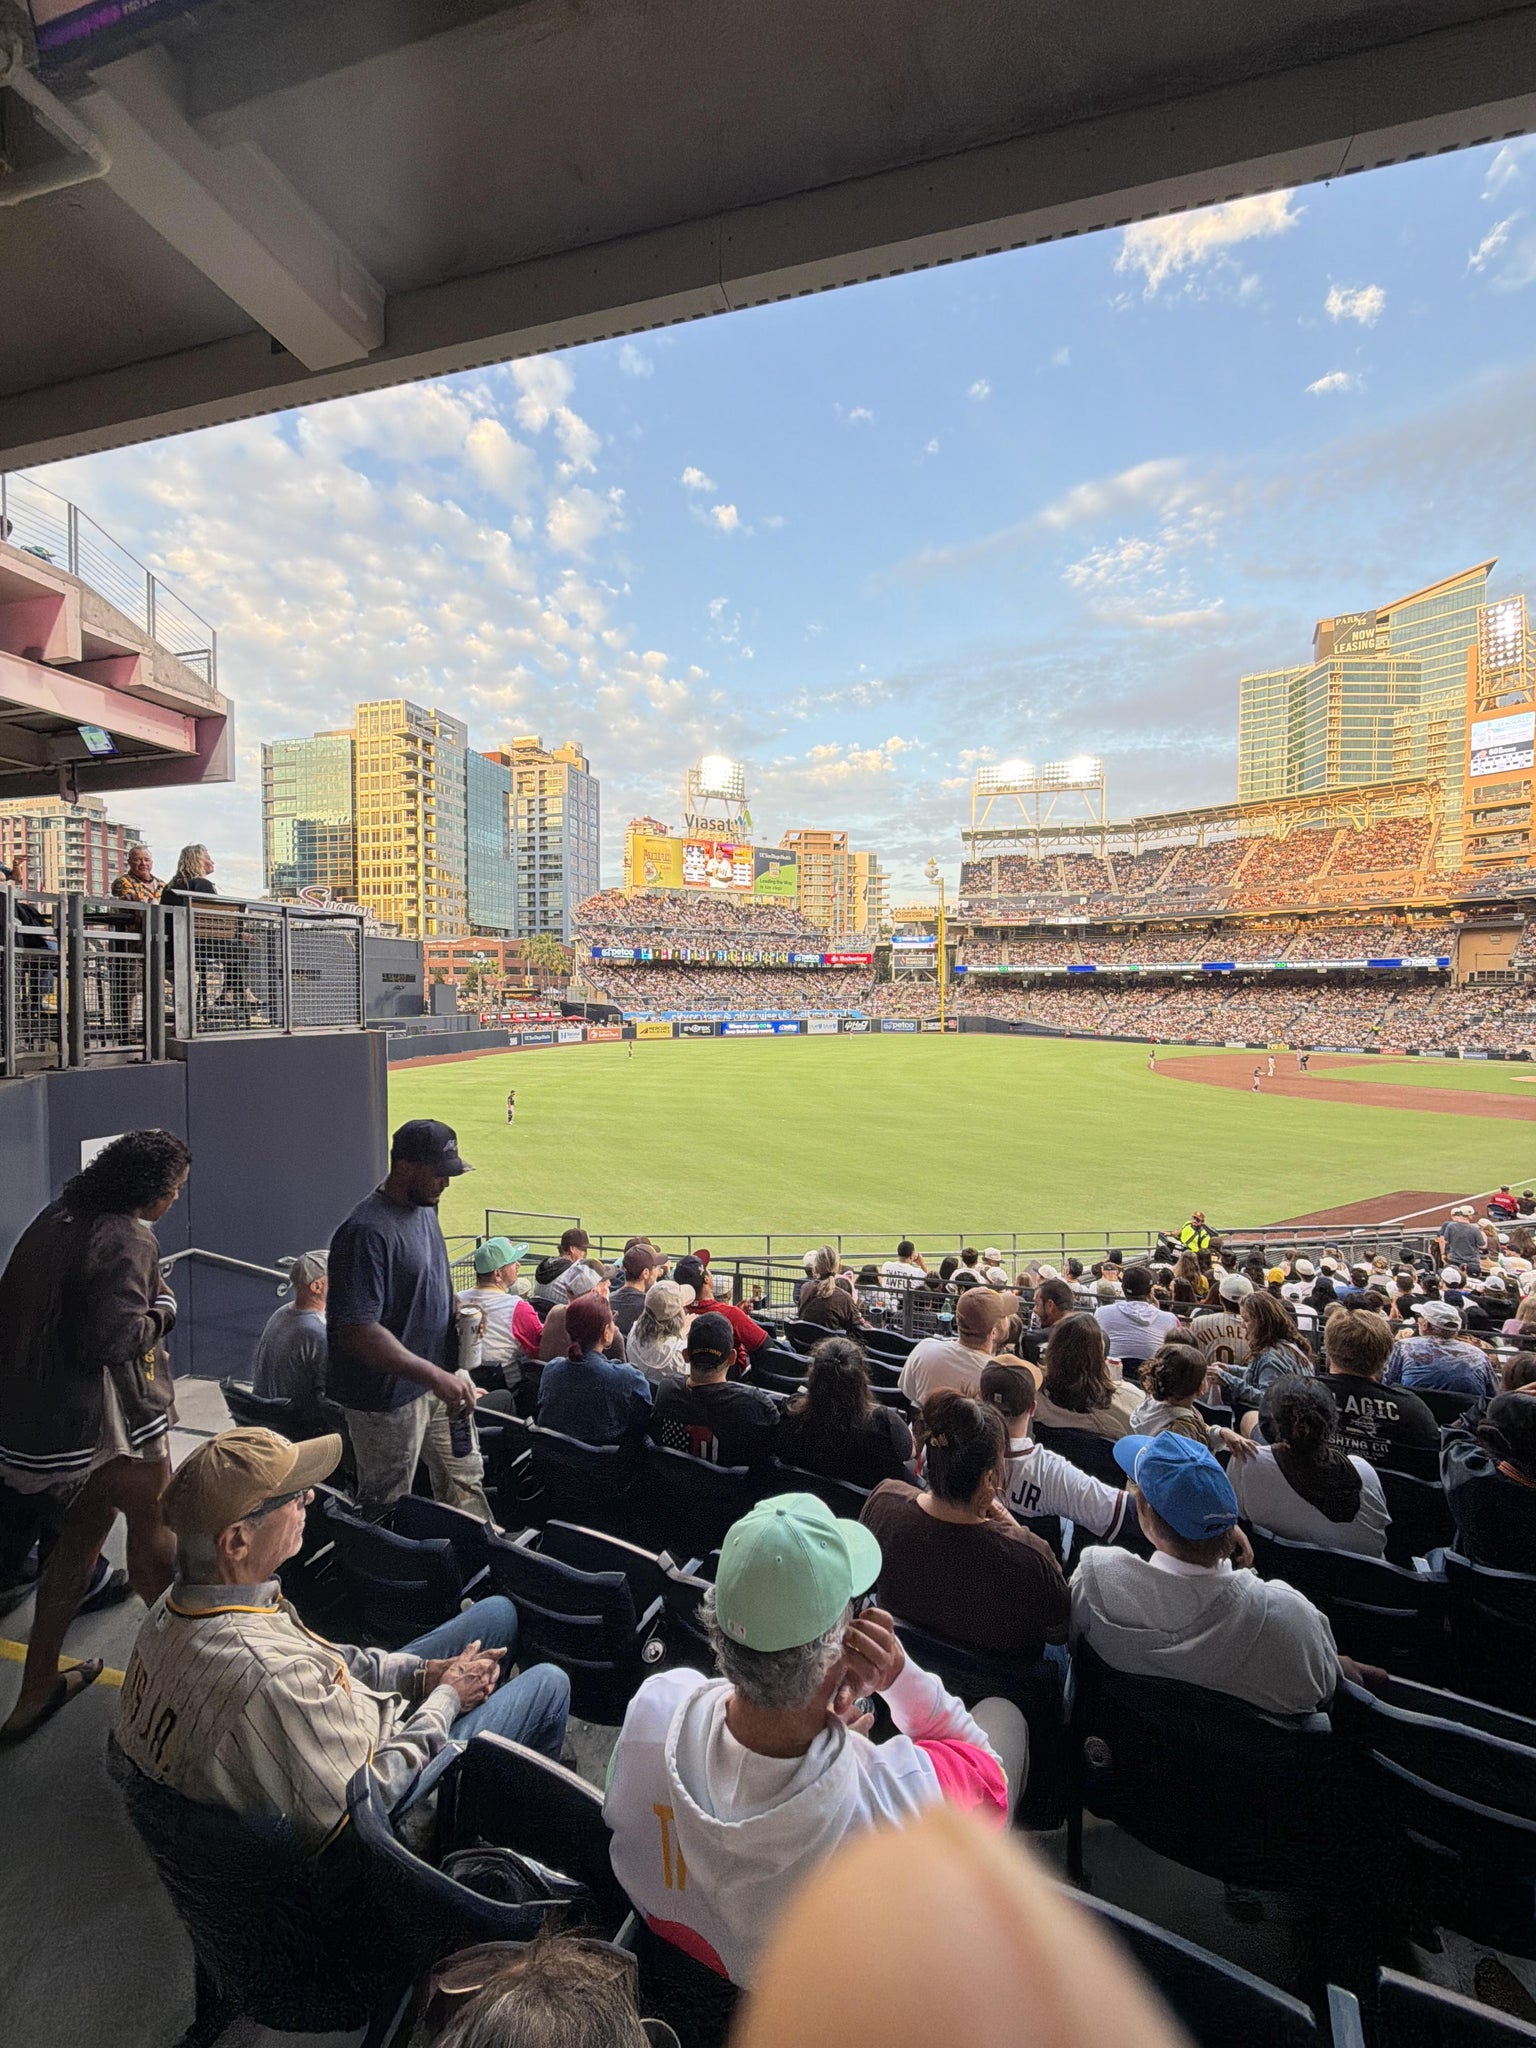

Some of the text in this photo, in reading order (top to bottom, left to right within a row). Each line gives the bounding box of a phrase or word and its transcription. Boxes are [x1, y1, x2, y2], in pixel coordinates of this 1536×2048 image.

[1335, 615, 1367, 626] PARK 12
[1352, 628, 1375, 641] NOW
[1334, 639, 1375, 654] LEASING
[684, 813, 733, 833] Viasat
[611, 948, 635, 958] petco
[802, 954, 820, 962] petco
[840, 954, 867, 962] Budweiser
[1412, 957, 1438, 967] petco
[886, 1278, 916, 1289] AWFUL
[1197, 1325, 1250, 1346] VILLAL
[1011, 1480, 1042, 1512] JR.
